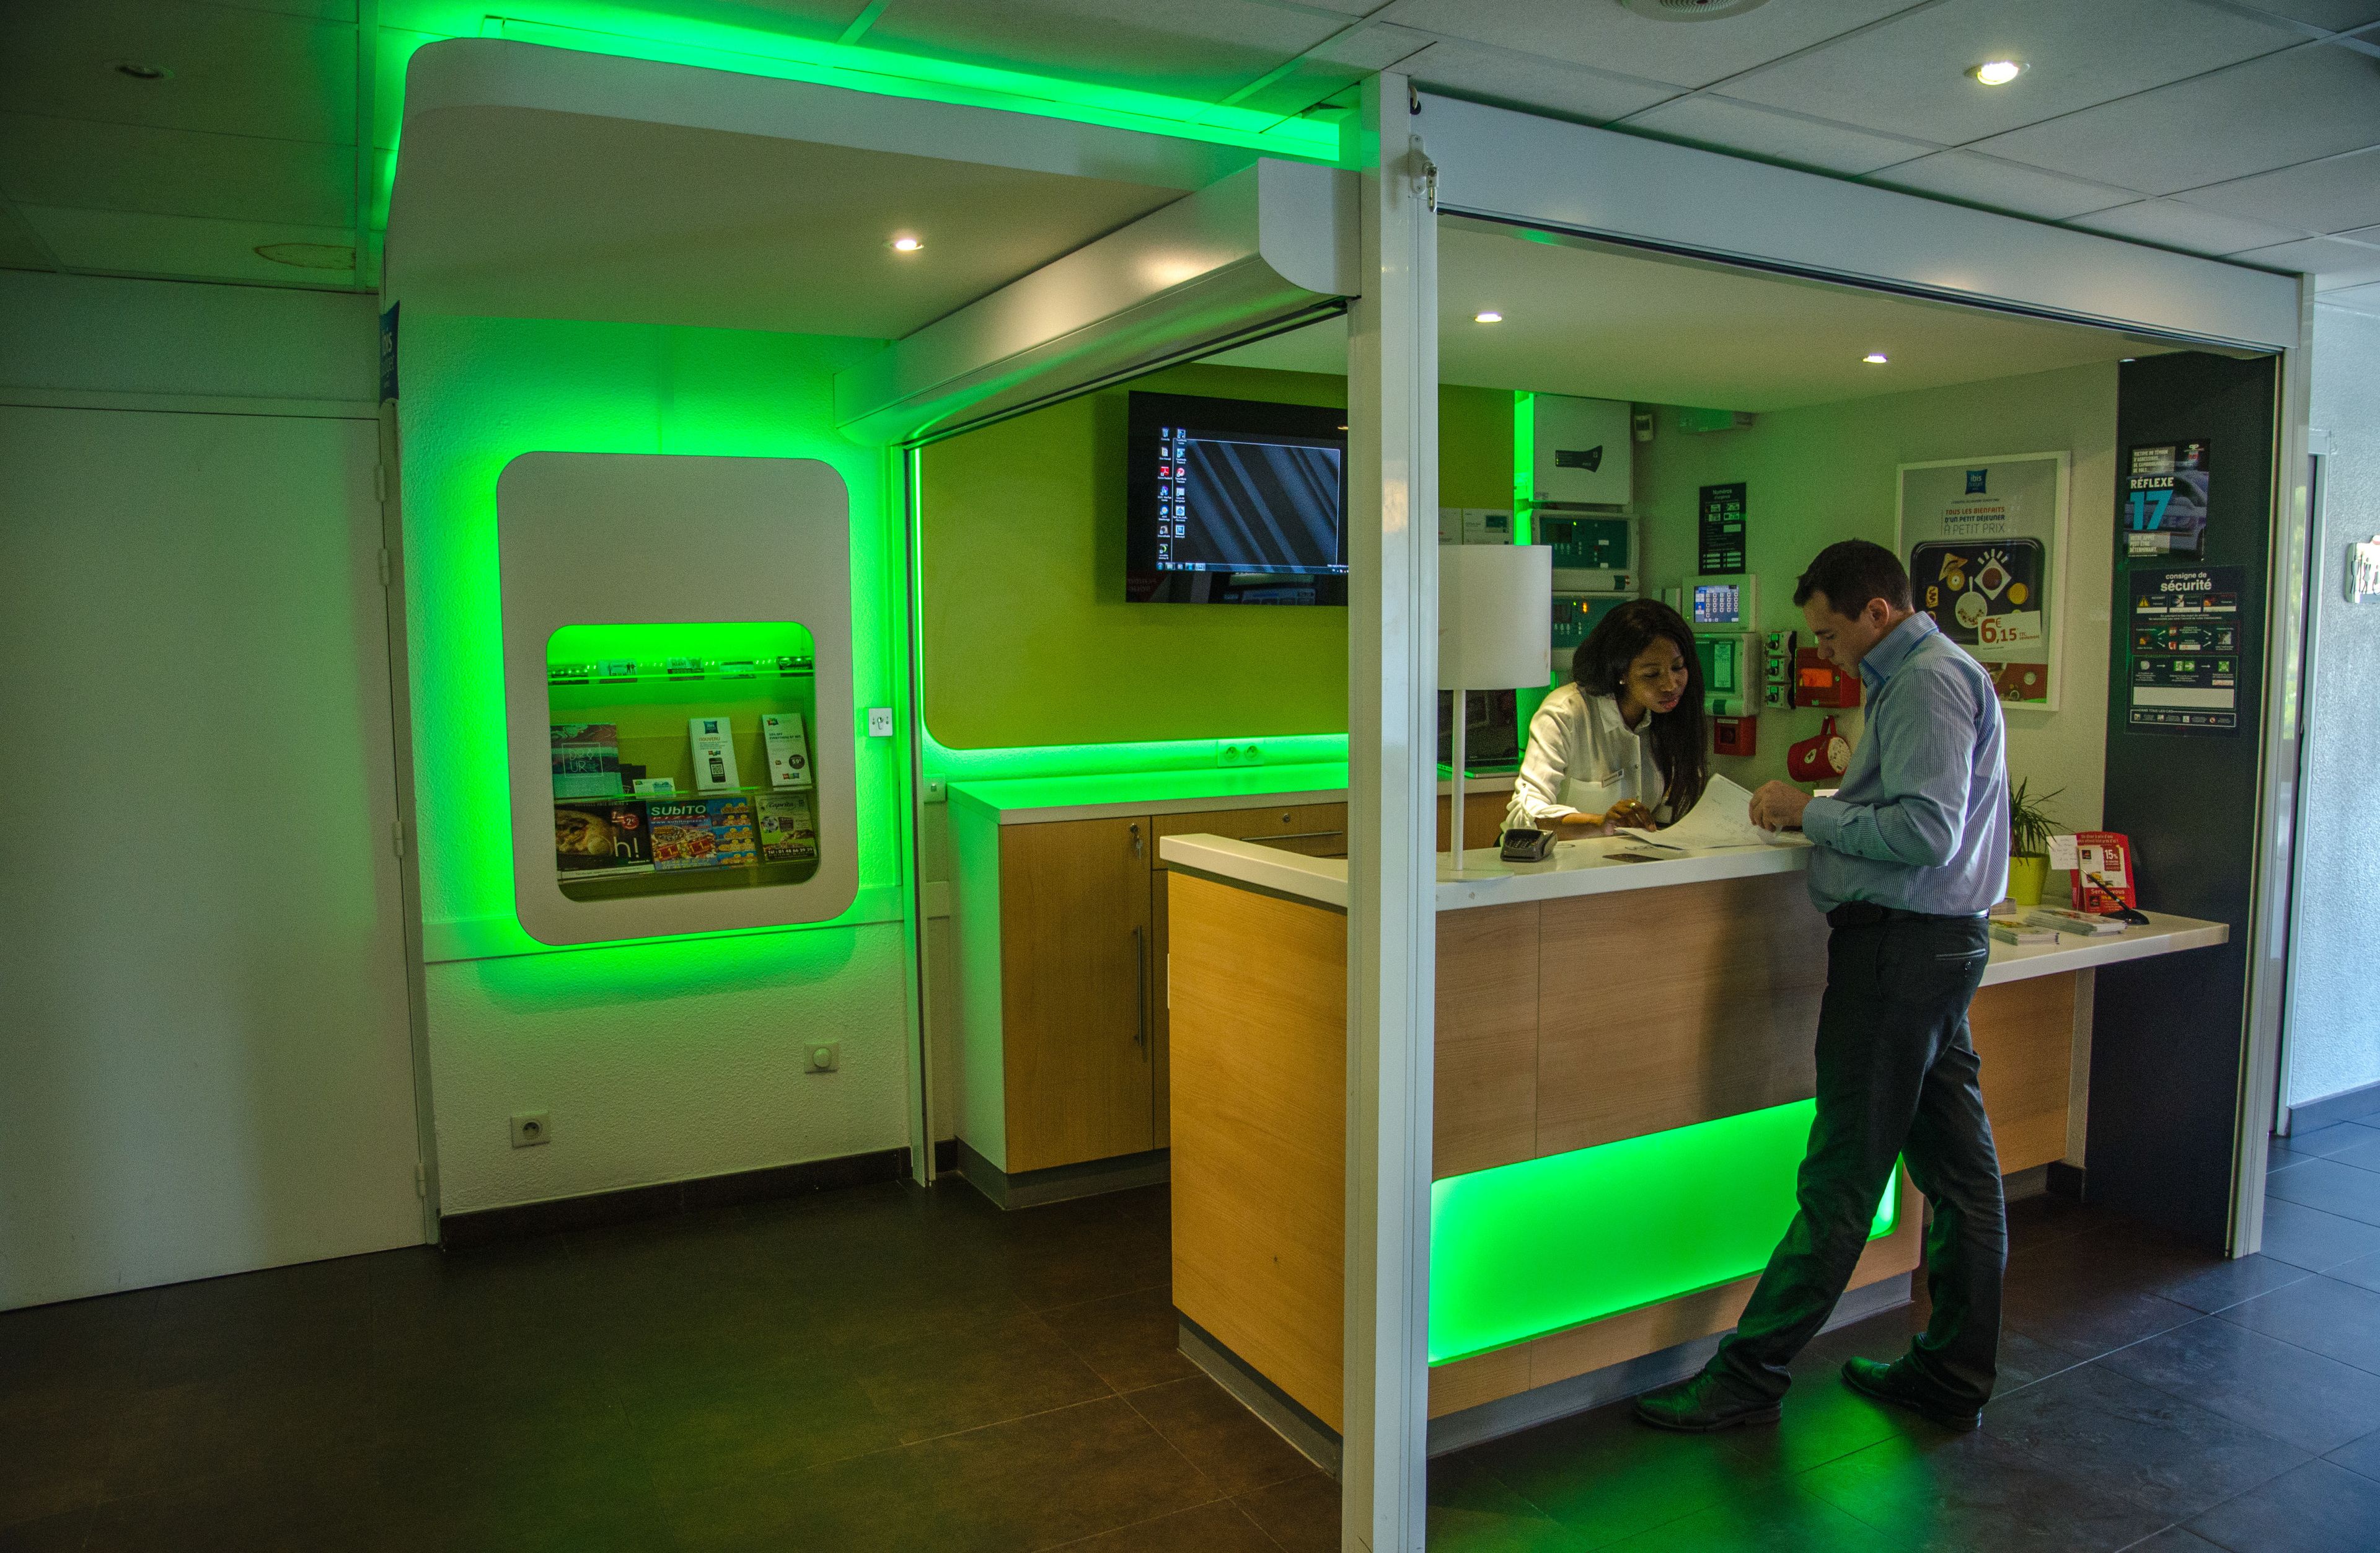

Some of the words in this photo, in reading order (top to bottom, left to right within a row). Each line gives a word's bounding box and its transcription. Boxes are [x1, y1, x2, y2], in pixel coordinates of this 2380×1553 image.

[2130, 476, 2174, 489] RÉFLEXE
[2130, 490, 2174, 531] 17
[1976, 513, 2005, 522] DÉJEUNER
[1944, 522, 1950, 536] À
[1953, 523, 1980, 535] PETIT
[1983, 523, 2005, 534] PRIX
[2165, 572, 2197, 580] consigne
[2160, 578, 2212, 592] sécurité
[2104, 849, 2118, 860] 15%
